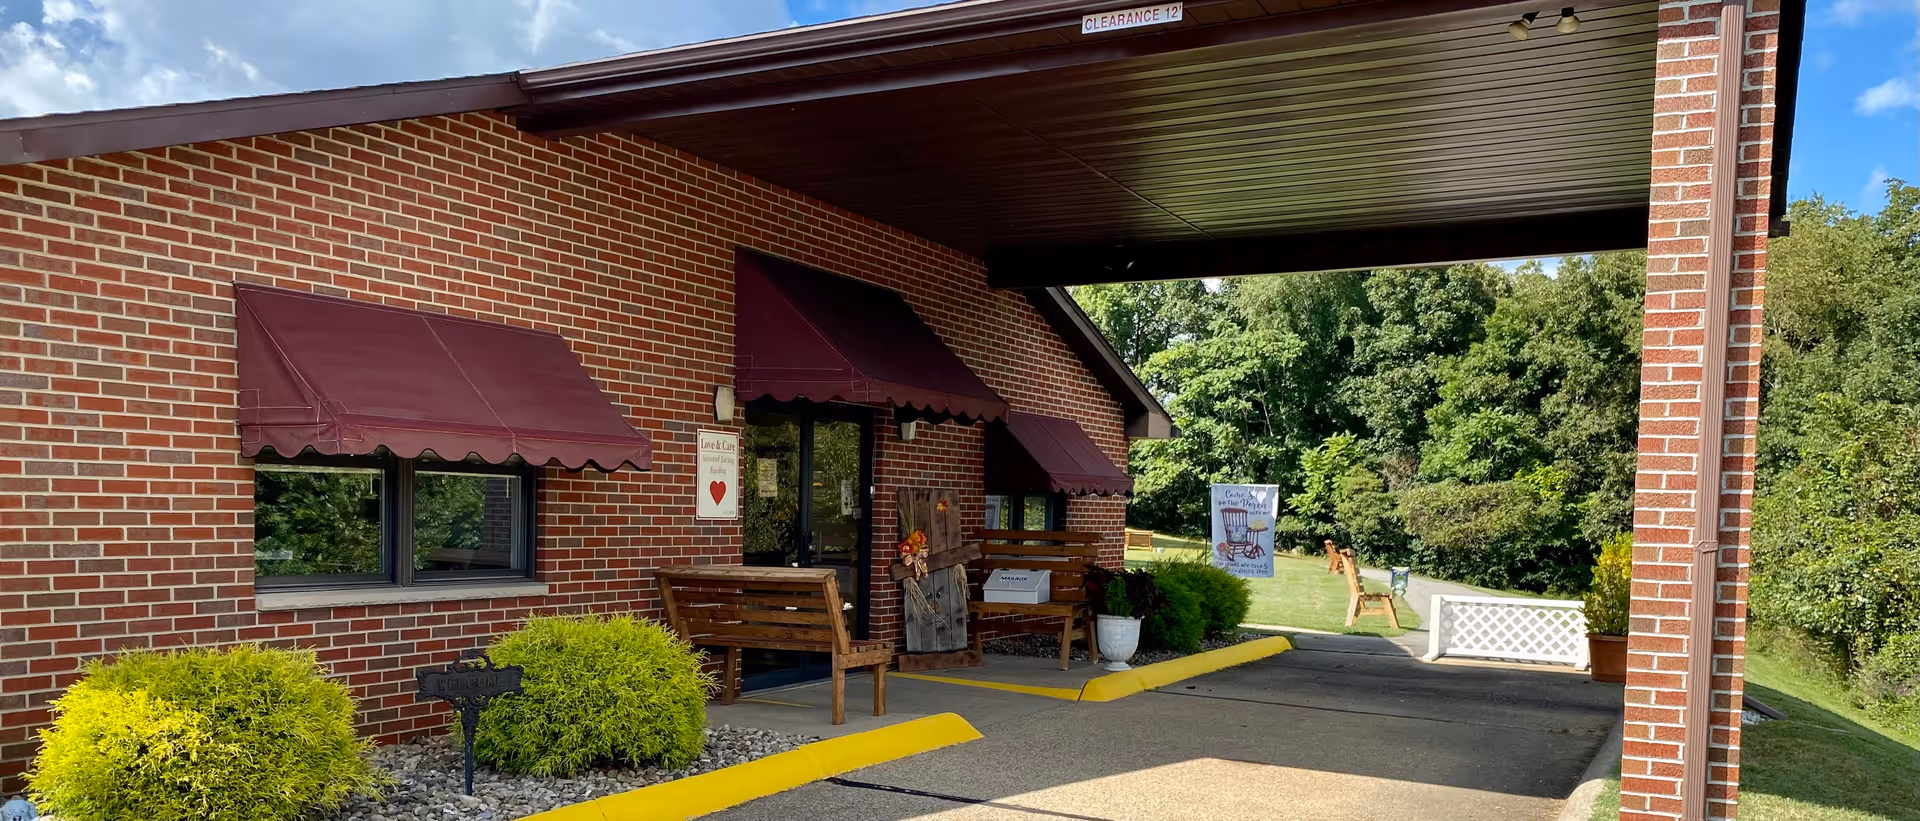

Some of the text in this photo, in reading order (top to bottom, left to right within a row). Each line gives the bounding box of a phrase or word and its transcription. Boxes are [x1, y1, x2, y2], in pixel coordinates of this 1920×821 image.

[1084, 5, 1182, 31] CLEARANCE 12'
[701, 438, 736, 451] Love & Care
[1225, 489, 1245, 499] Come
[438, 674, 509, 691] WELCOME
